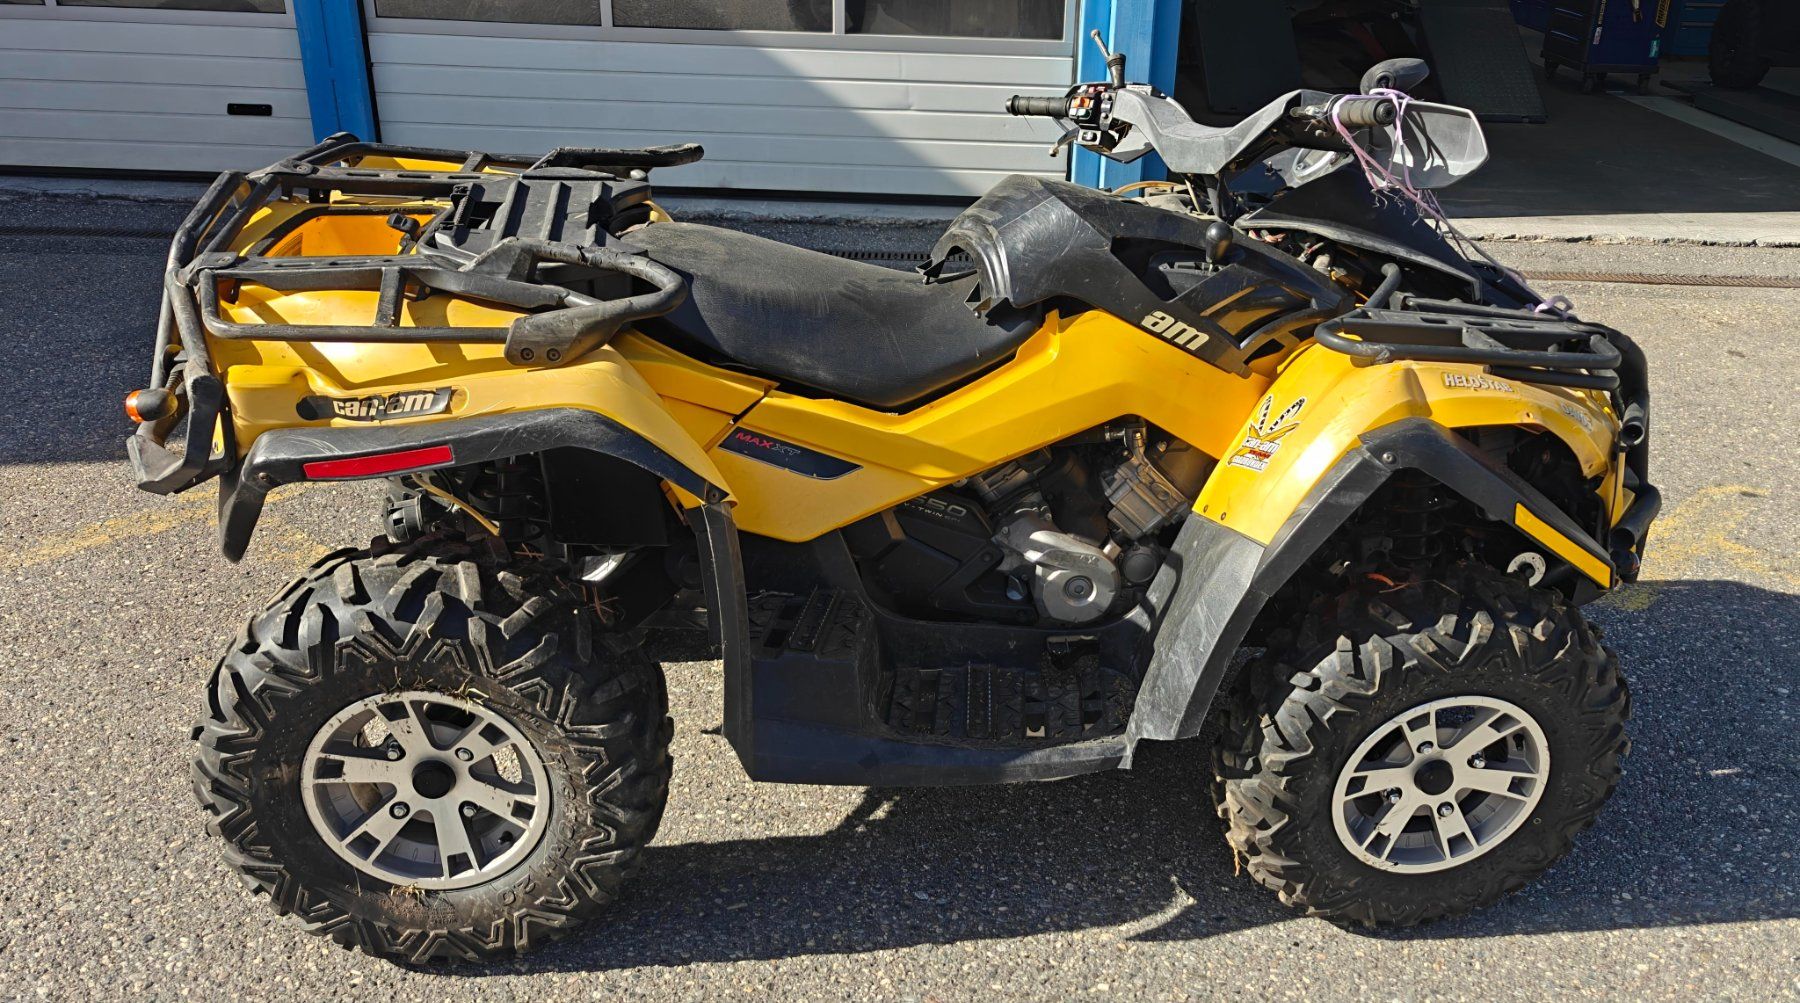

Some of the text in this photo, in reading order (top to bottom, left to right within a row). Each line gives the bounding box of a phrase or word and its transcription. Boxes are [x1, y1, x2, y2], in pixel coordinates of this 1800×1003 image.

[1141, 311, 1210, 350] am
[333, 393, 434, 416] can-am
[735, 432, 773, 449] MAX
